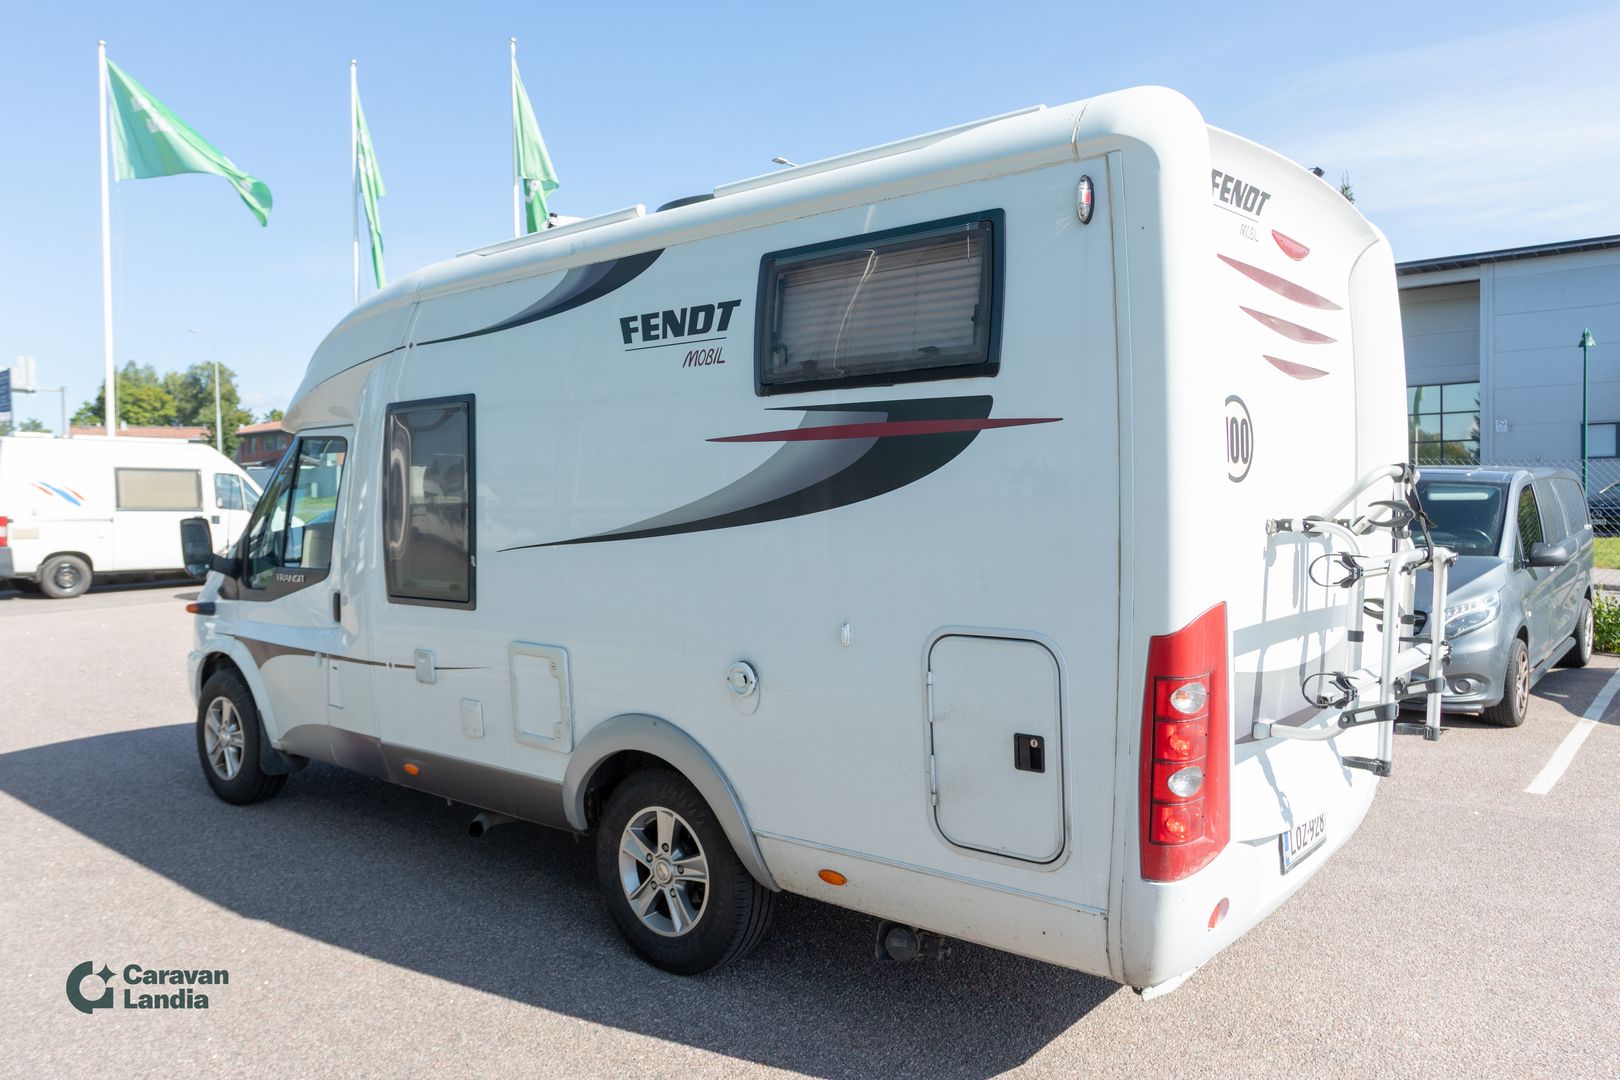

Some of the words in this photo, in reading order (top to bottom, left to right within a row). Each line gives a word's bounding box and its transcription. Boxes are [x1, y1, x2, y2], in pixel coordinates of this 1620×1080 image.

[1211, 168, 1271, 216] FENDT
[619, 299, 742, 345] FENDT
[682, 347, 726, 369] MOBIL
[275, 573, 305, 583] TRANSIT
[1289, 813, 1325, 856] LOZ-928
